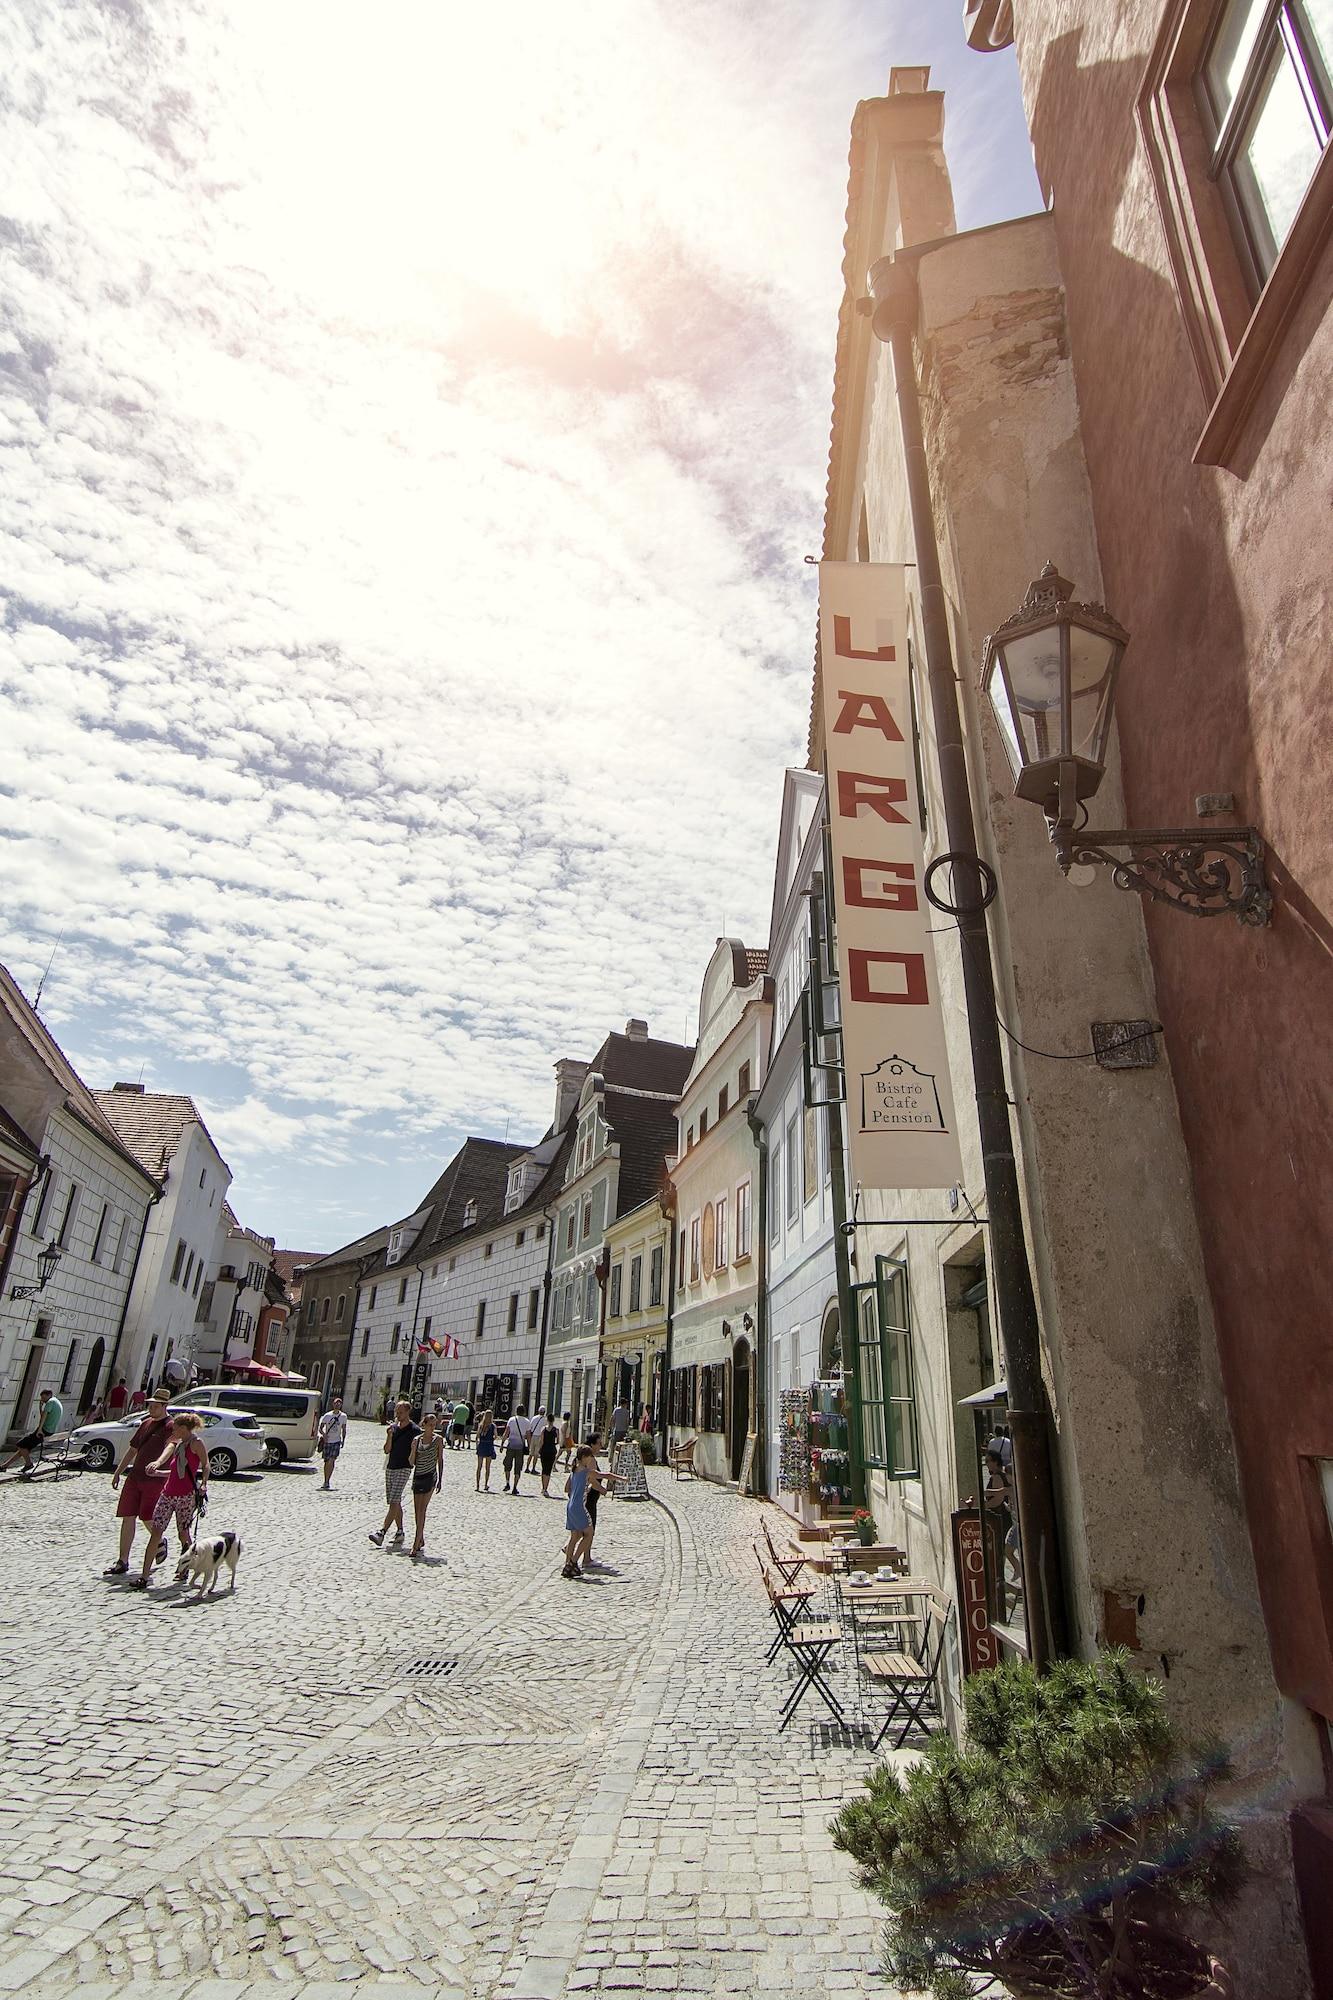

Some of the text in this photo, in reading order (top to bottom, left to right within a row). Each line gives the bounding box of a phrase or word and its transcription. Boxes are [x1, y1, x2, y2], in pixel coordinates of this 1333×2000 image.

[832, 614, 929, 1006] LARGO
[876, 1081, 922, 1094] Bistro
[883, 1096, 918, 1108] Cafe
[872, 1110, 933, 1123] Pension
[501, 1376, 511, 1413] café
